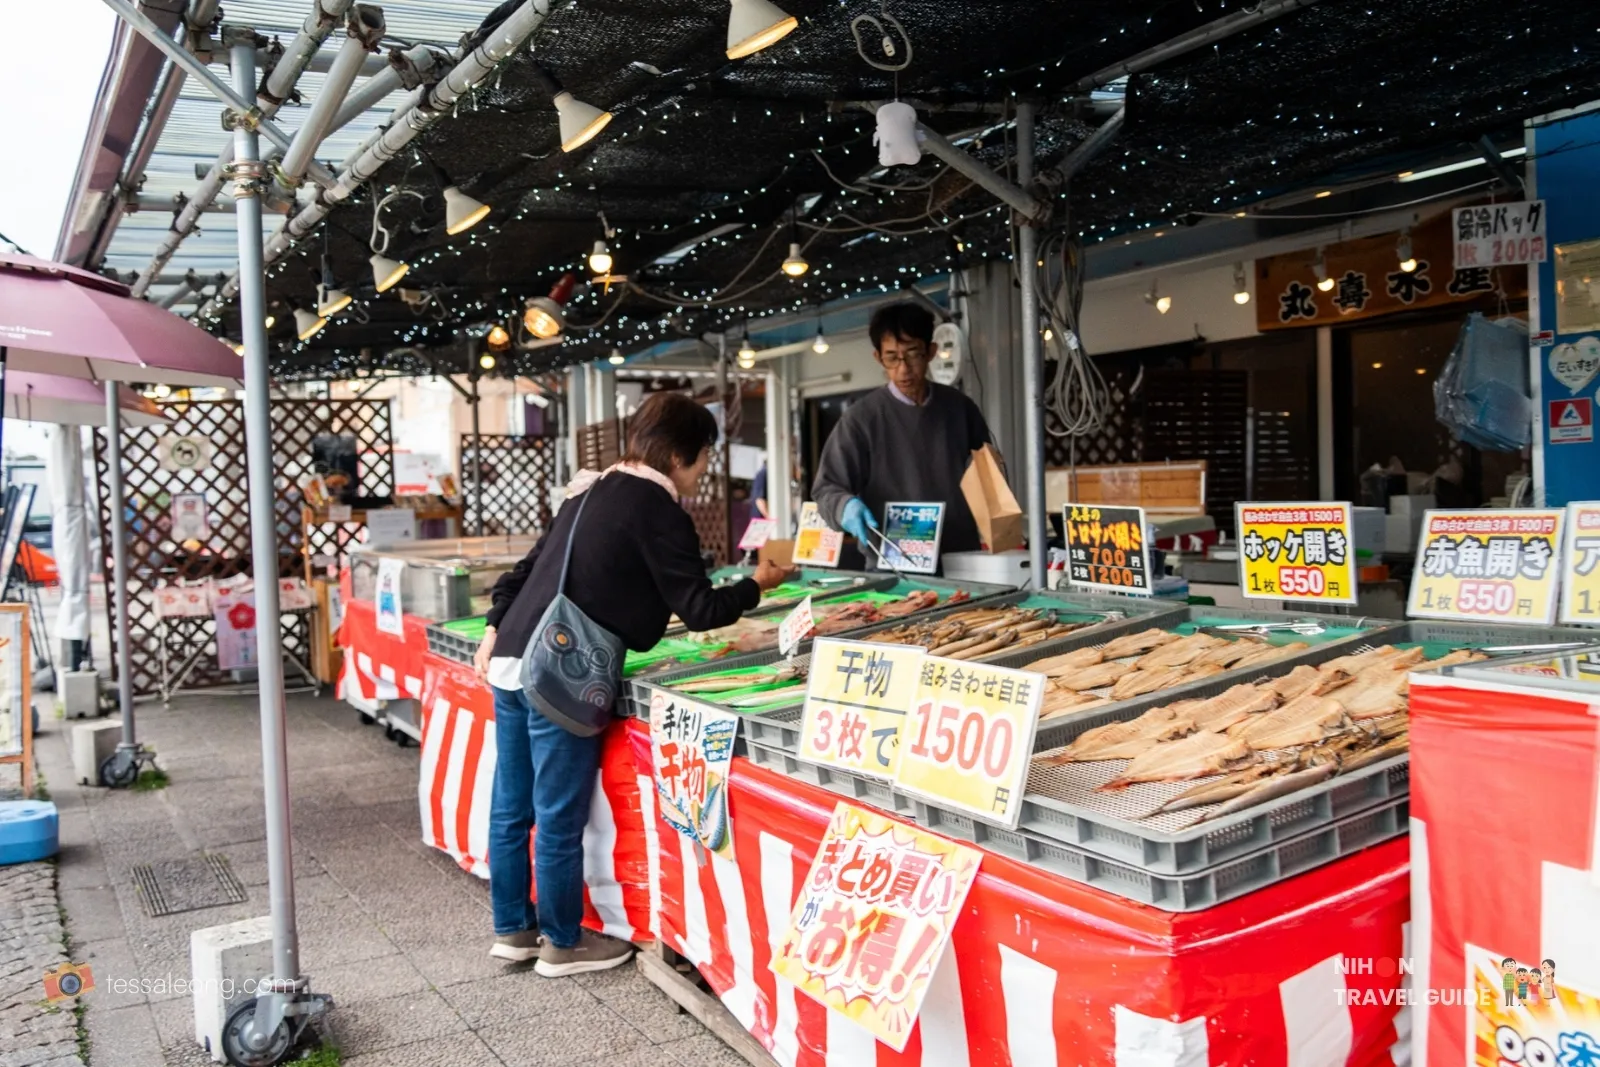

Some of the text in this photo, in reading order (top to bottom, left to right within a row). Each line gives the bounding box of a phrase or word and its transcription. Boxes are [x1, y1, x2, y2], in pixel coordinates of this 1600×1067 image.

[1244, 528, 1347, 566] ホッケ開き
[1422, 535, 1552, 580] 赤魚開き
[836, 649, 894, 698] 干物
[920, 660, 1031, 706] 組み合わせ自由
[662, 702, 702, 742] 手作り
[910, 702, 1013, 777] 1500
[660, 742, 706, 804] 干物
[992, 786, 1010, 814] 円
[812, 837, 956, 914] まとめ買い
[799, 896, 824, 927] が
